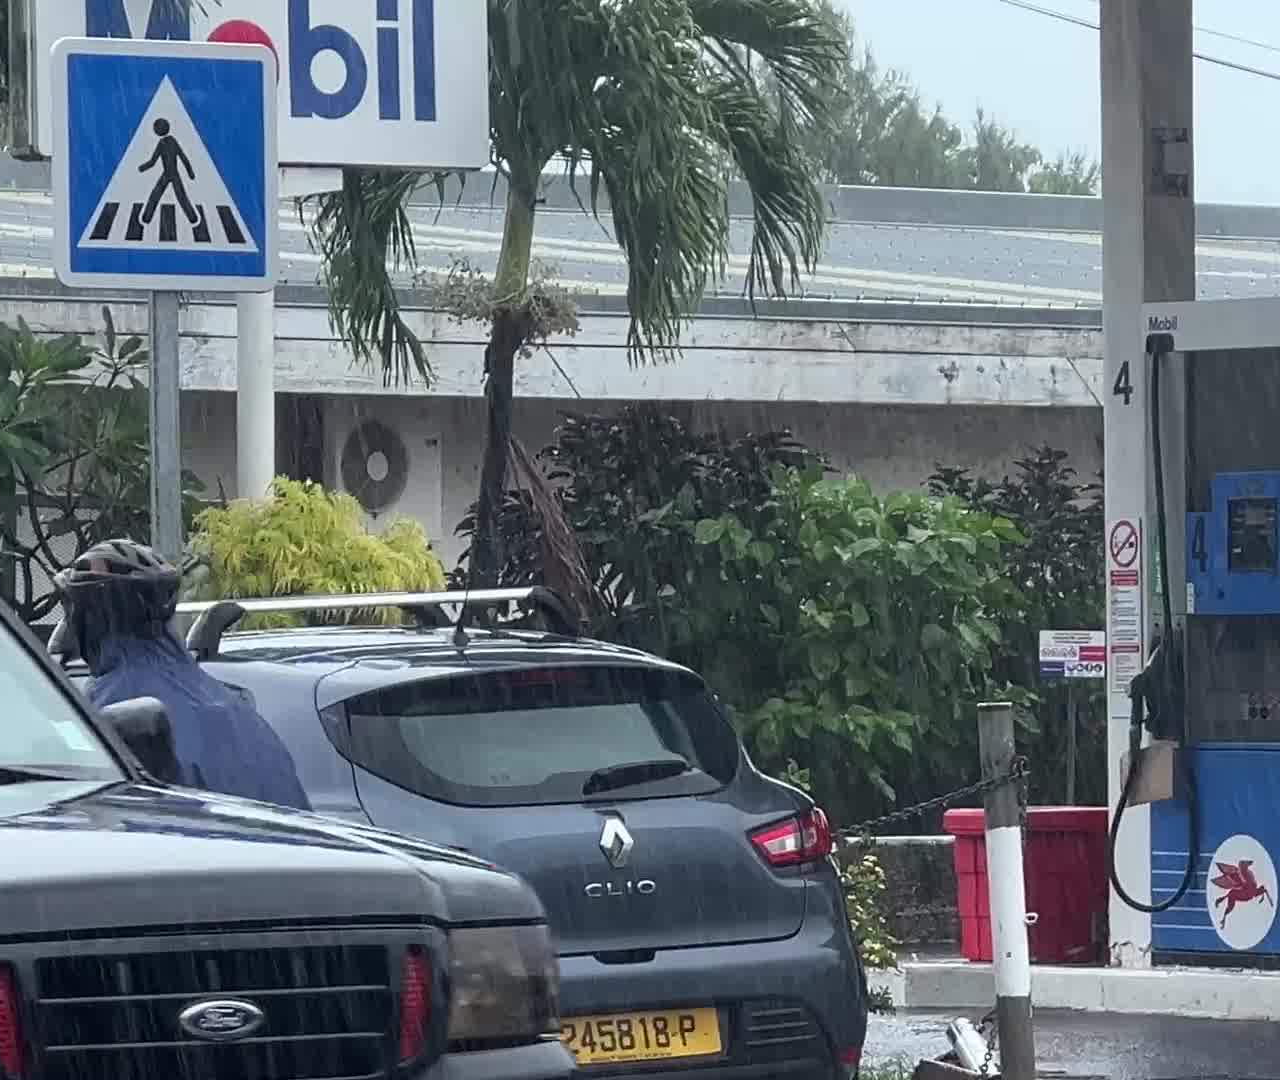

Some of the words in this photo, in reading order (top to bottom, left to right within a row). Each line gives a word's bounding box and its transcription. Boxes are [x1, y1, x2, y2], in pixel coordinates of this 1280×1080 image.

[85, 0, 437, 121] bil
[1147, 315, 1178, 331] Mobil
[1113, 360, 1133, 405] 4
[1191, 515, 1208, 573] 4
[584, 879, 656, 897] CLIO
